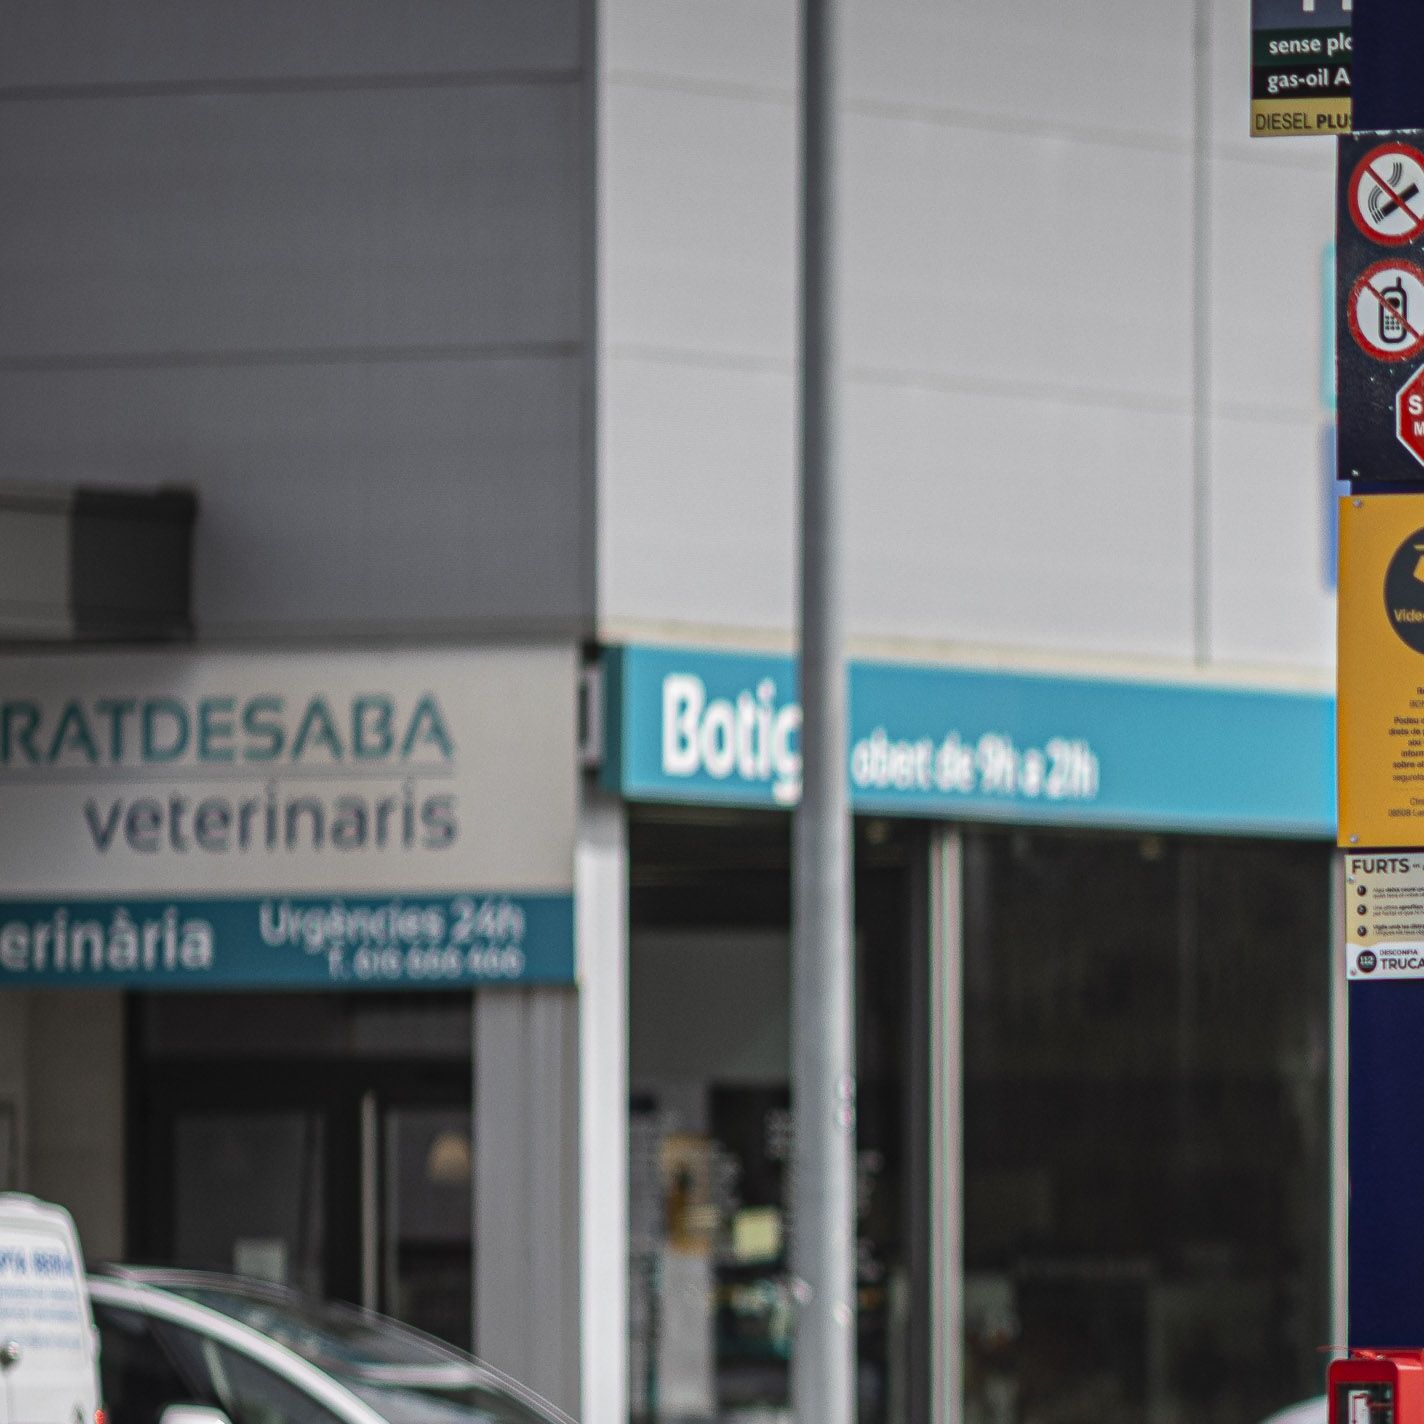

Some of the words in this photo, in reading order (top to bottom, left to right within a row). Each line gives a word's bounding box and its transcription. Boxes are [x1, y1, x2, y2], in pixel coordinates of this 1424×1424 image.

[1268, 38, 1322, 55] sense
[1267, 68, 1330, 94] gas-oil
[1333, 67, 1352, 86] A
[1255, 112, 1313, 131] DIESEL
[1316, 113, 1352, 130] PLU
[0, 695, 457, 765] RATDESABA
[83, 778, 460, 854] veterinaris
[1352, 858, 1410, 875] FURTS
